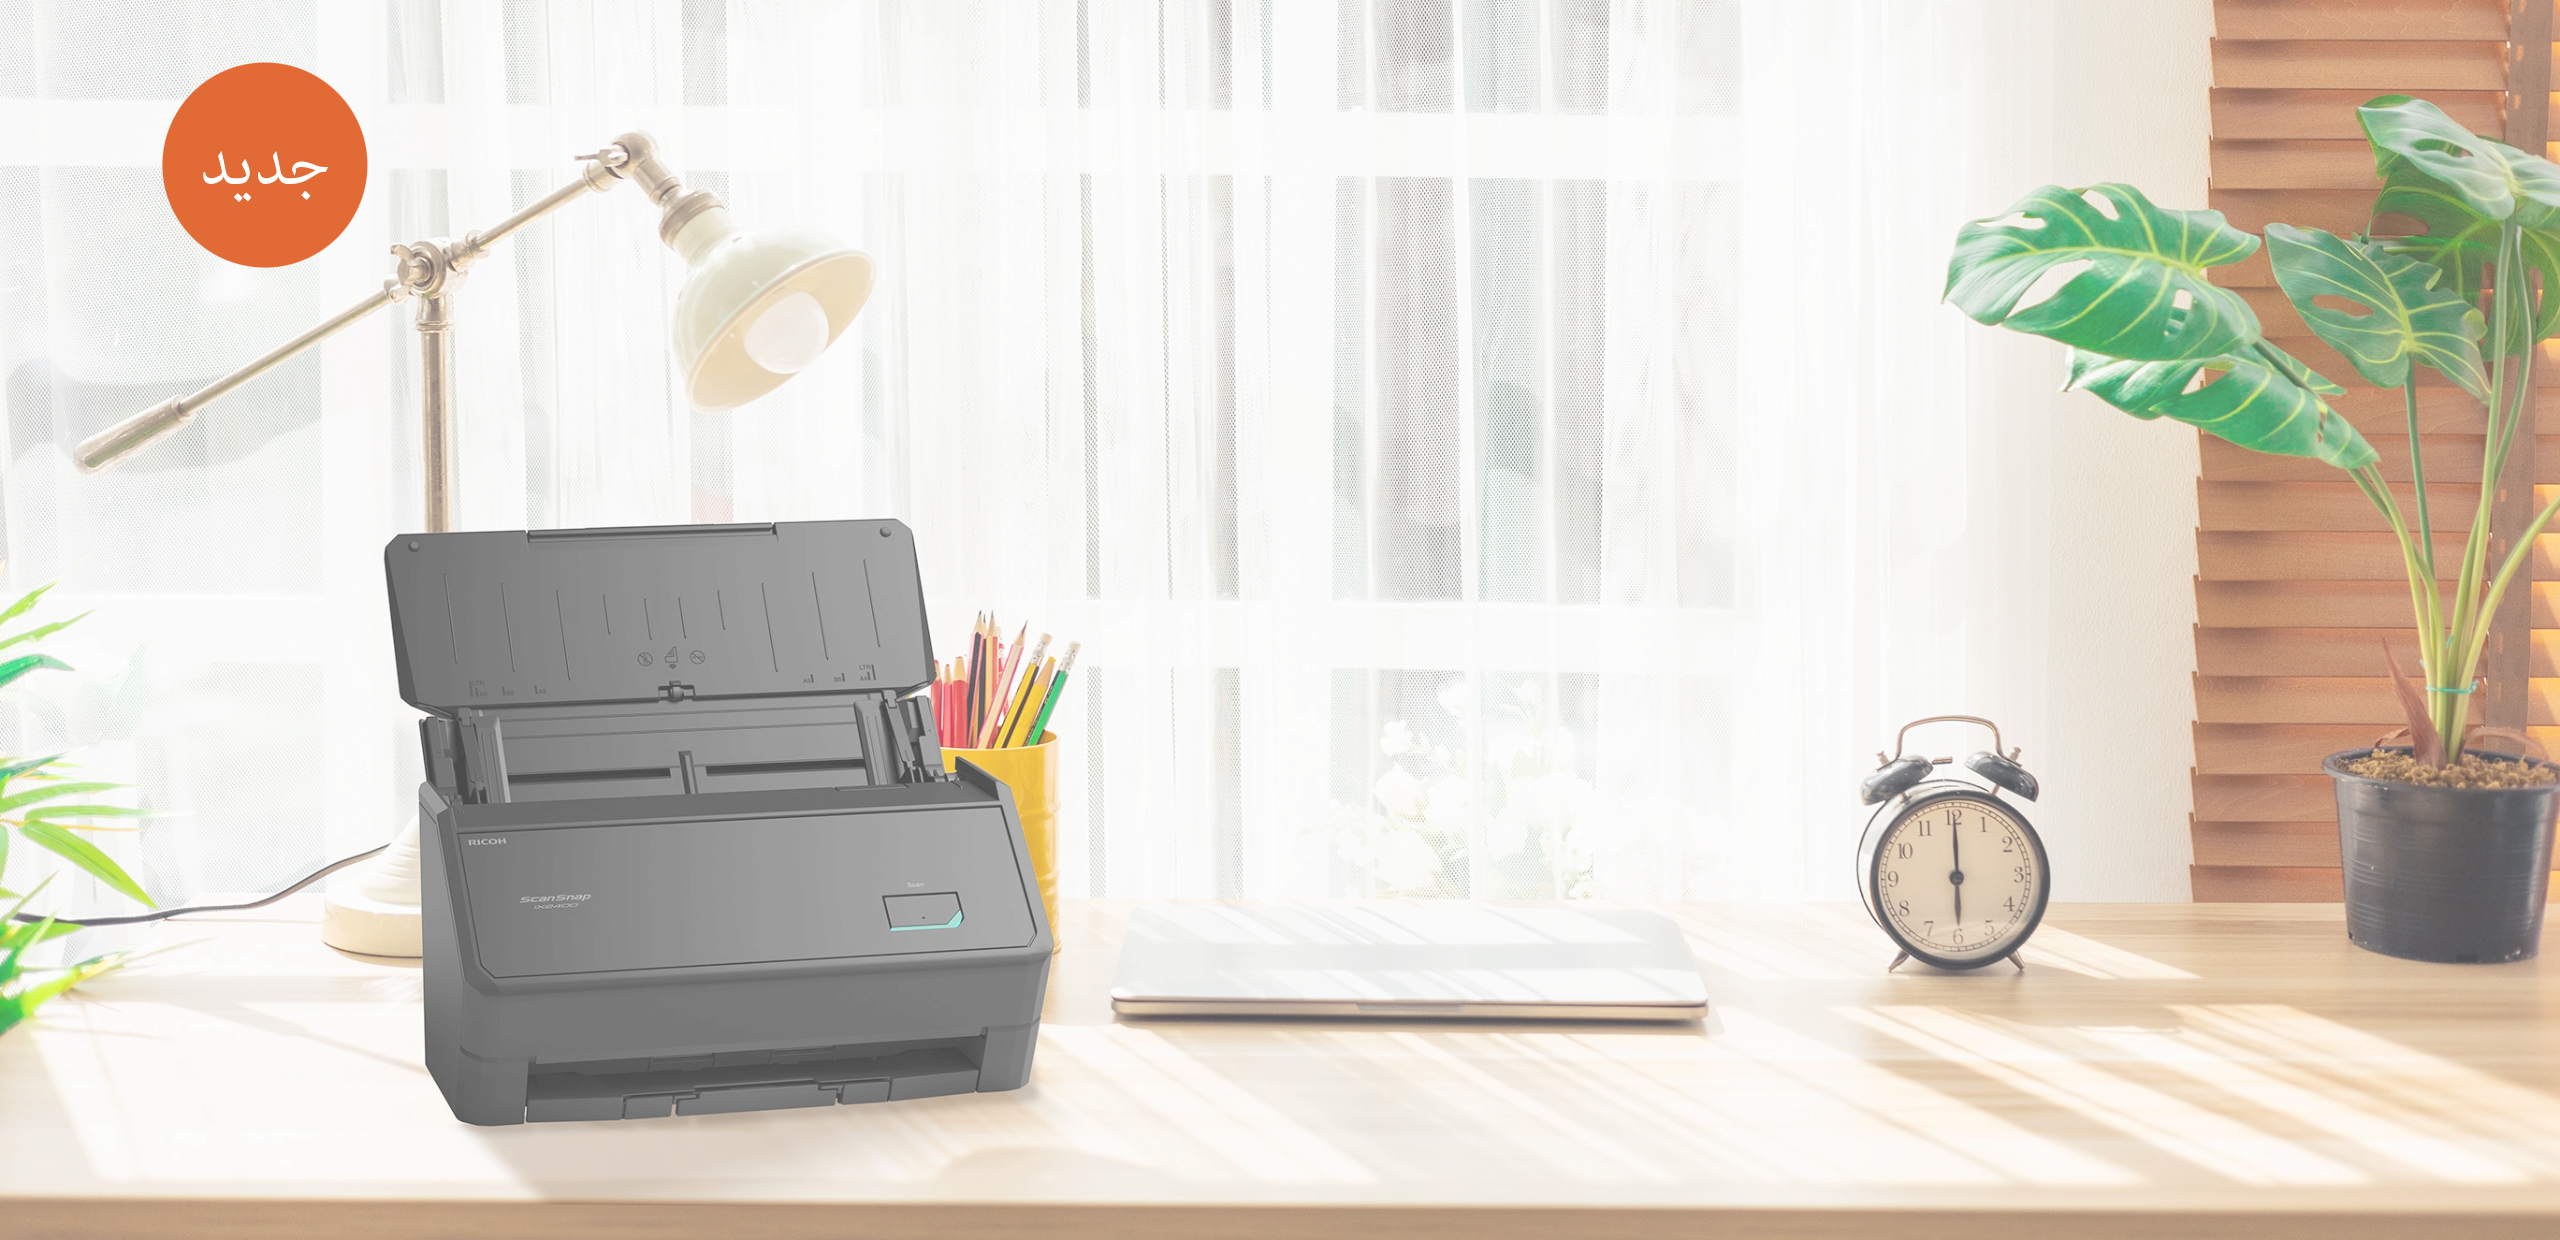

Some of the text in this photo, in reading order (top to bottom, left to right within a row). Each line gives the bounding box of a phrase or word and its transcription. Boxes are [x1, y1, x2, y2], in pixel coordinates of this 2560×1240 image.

[1944, 808, 1963, 826] 12
[1980, 816, 1988, 833] 1
[1917, 819, 1933, 837] 11
[467, 837, 507, 846] RICOH
[1897, 841, 1914, 860] 10
[2001, 835, 2014, 853] 2
[1887, 870, 1899, 888] 9
[2013, 866, 2025, 884] 3
[519, 893, 592, 904] ScanSnap
[533, 902, 579, 910] iX2400
[2002, 895, 2016, 912] 4
[1898, 899, 1911, 917] 8
[1923, 920, 1935, 938] 7
[1952, 928, 1965, 945] 6
[1983, 919, 1995, 937] 5
